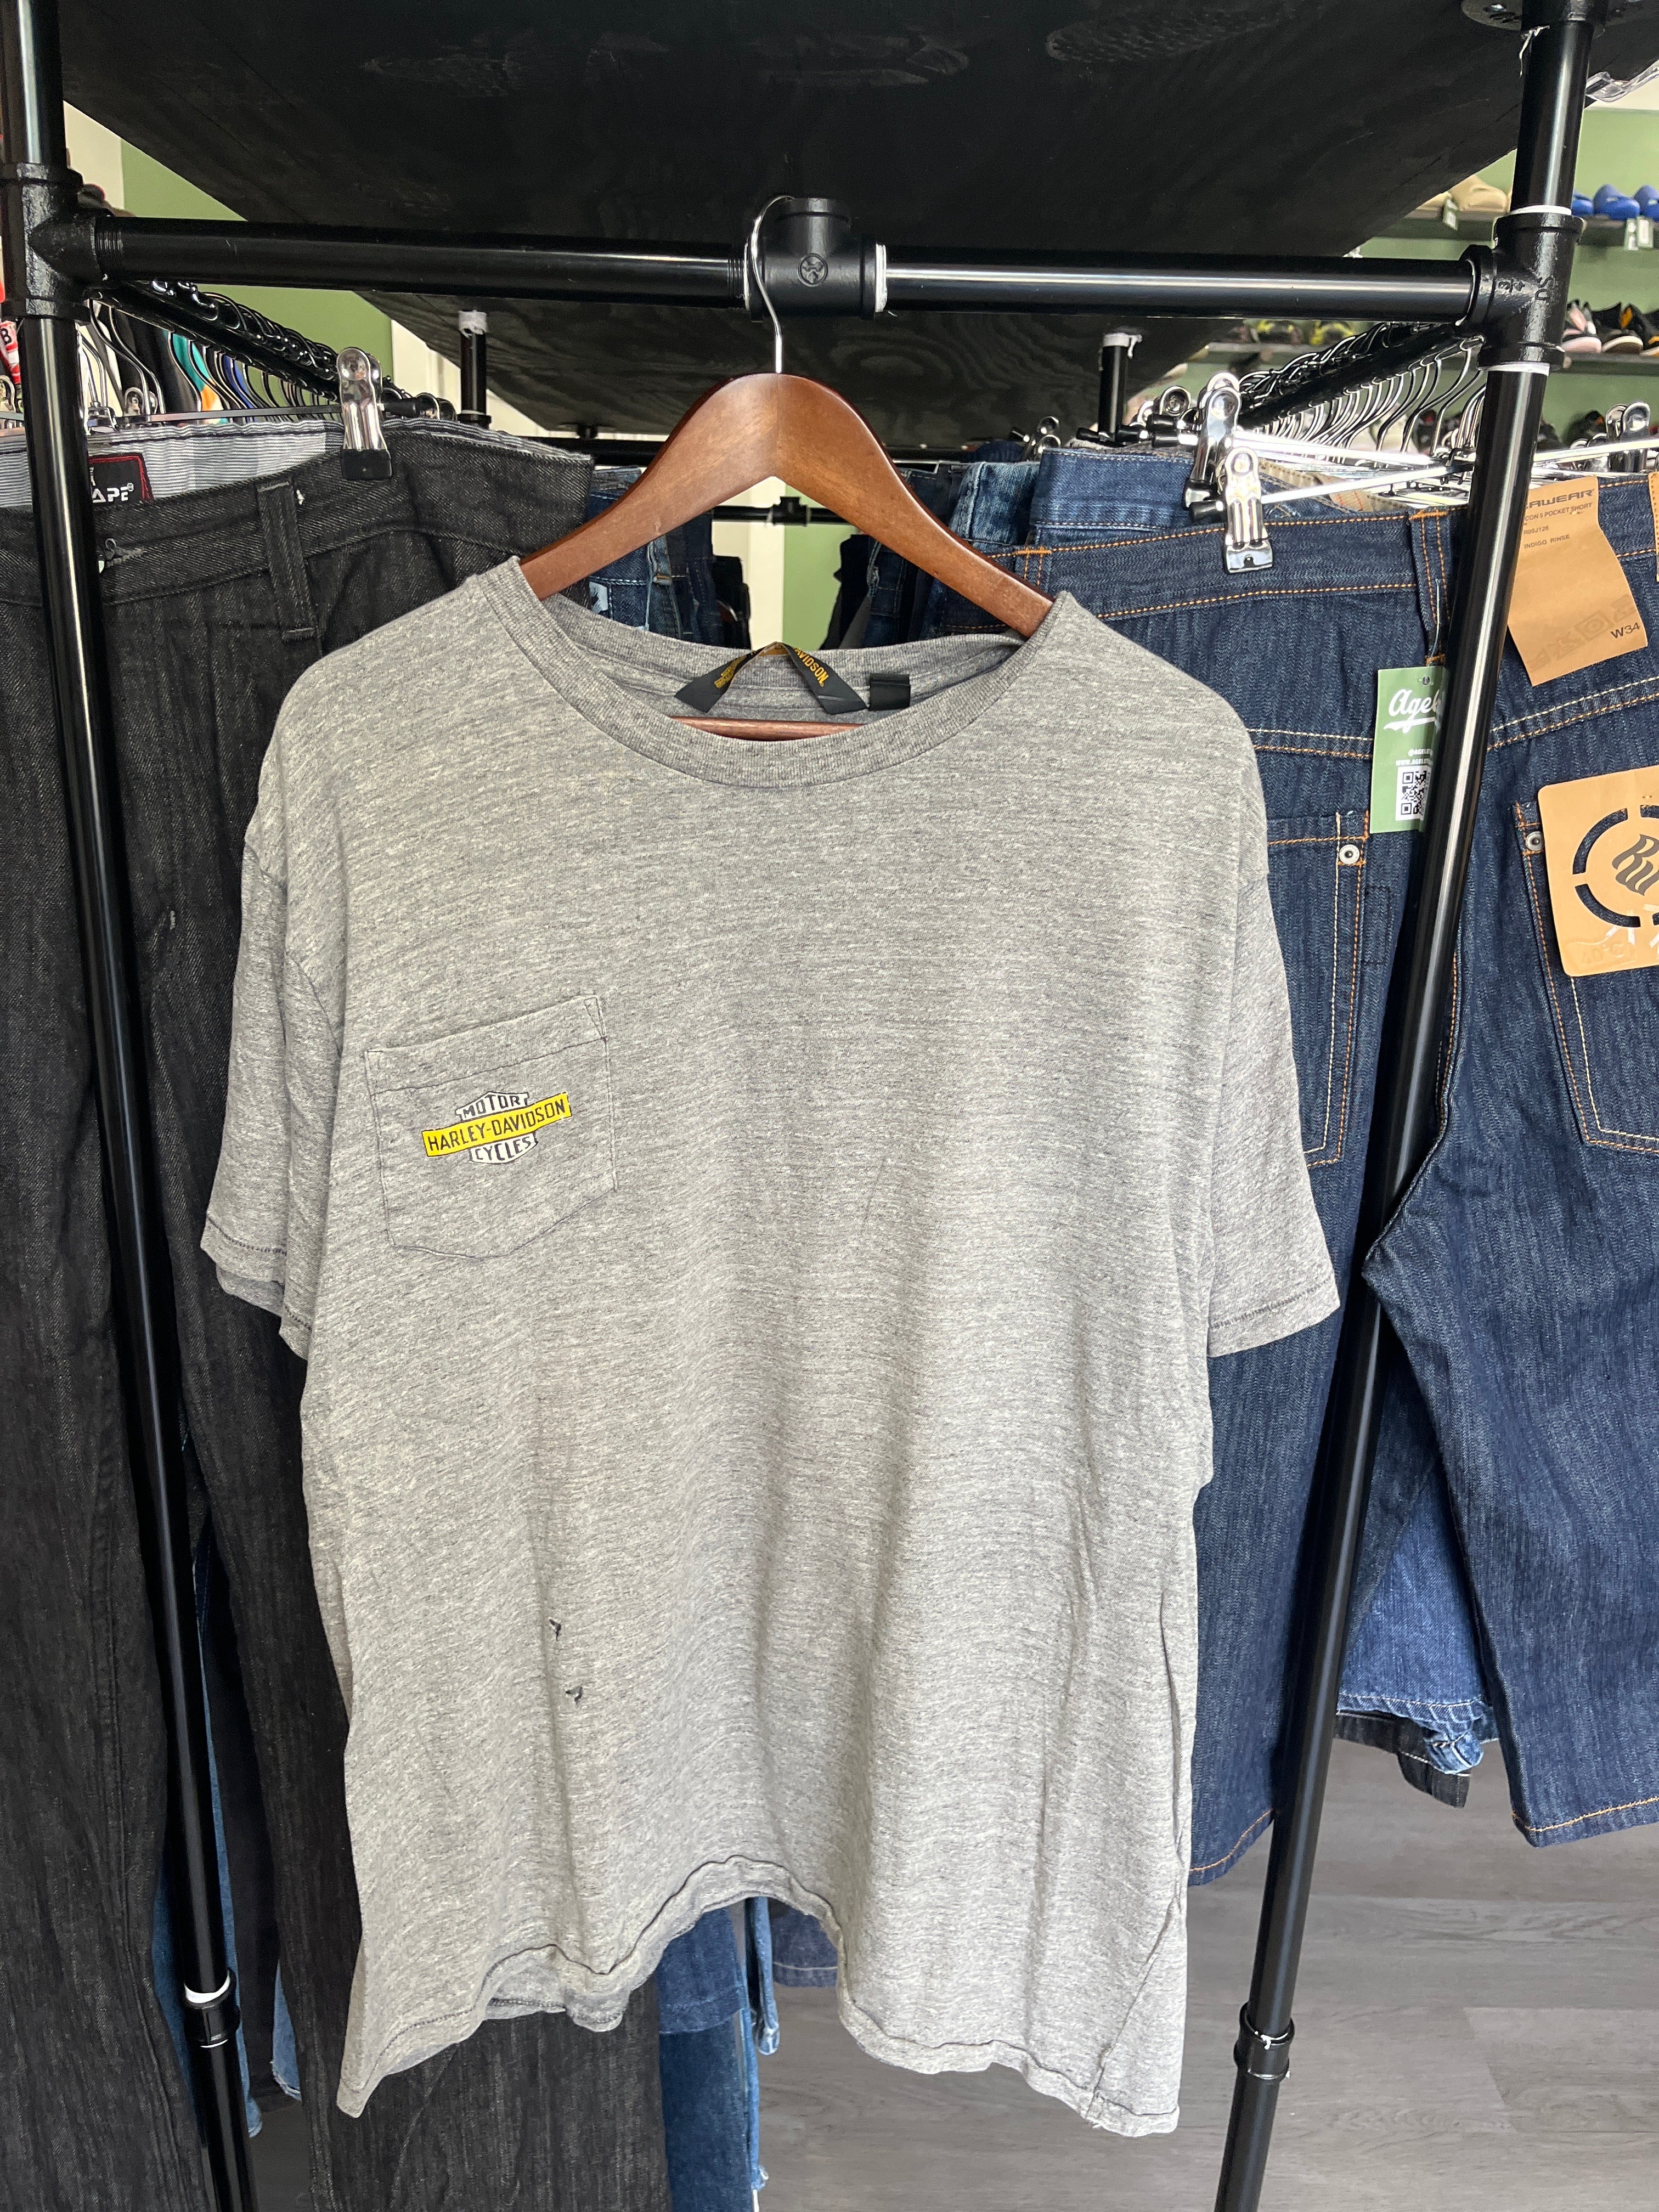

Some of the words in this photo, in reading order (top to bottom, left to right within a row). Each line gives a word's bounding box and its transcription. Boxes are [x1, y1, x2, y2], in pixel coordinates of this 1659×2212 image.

[1525, 489, 1593, 509] AWEAR
[1544, 507, 1570, 517] POCKET
[1571, 503, 1592, 512] SHORT
[1524, 539, 1547, 549] INDIGO
[1550, 534, 1571, 543] RINSE
[1610, 622, 1640, 639] W34
[462, 1094, 521, 1118] MOTOR
[428, 1098, 565, 1152] HARLEY-DAVIDSON
[475, 1136, 532, 1161] CYCLES
